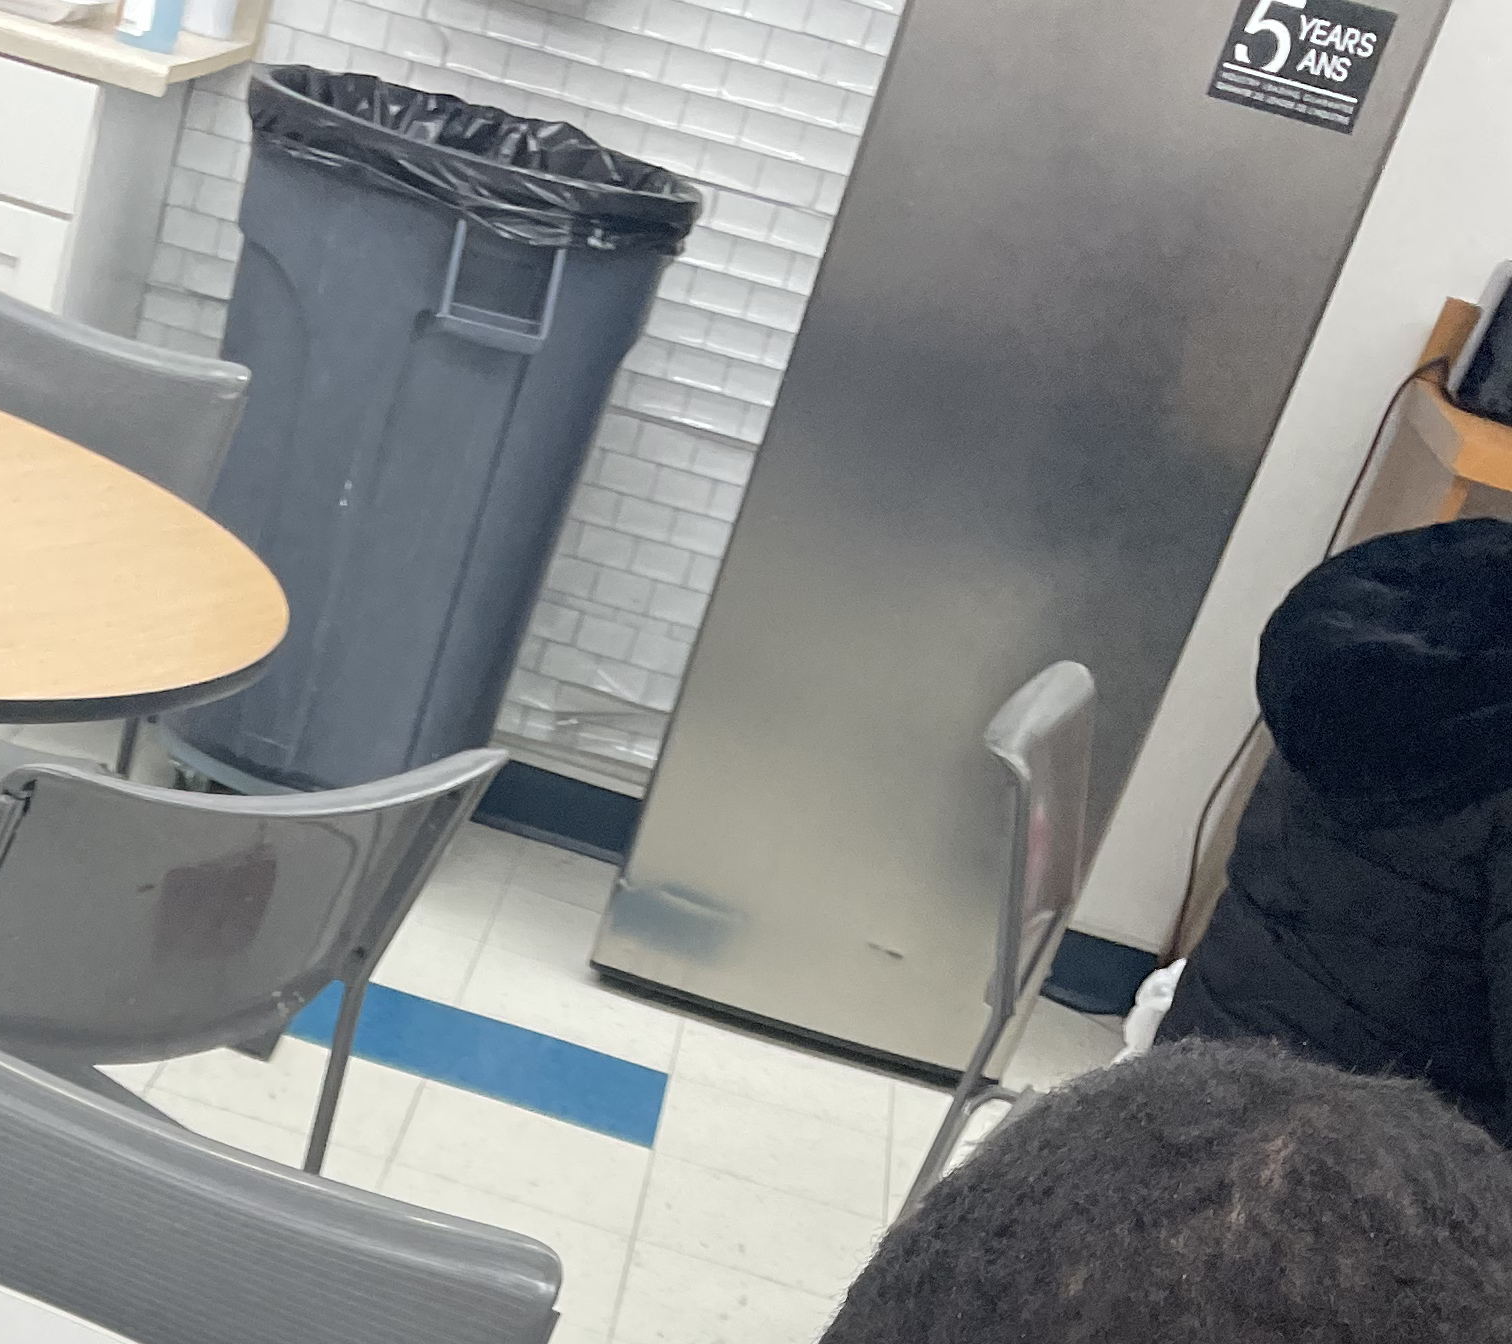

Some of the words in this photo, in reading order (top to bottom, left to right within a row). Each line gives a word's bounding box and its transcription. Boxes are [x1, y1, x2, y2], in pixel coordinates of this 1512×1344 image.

[1234, 0, 1307, 73] 5
[1299, 14, 1377, 58] YEARS
[1296, 49, 1352, 82] ANS
